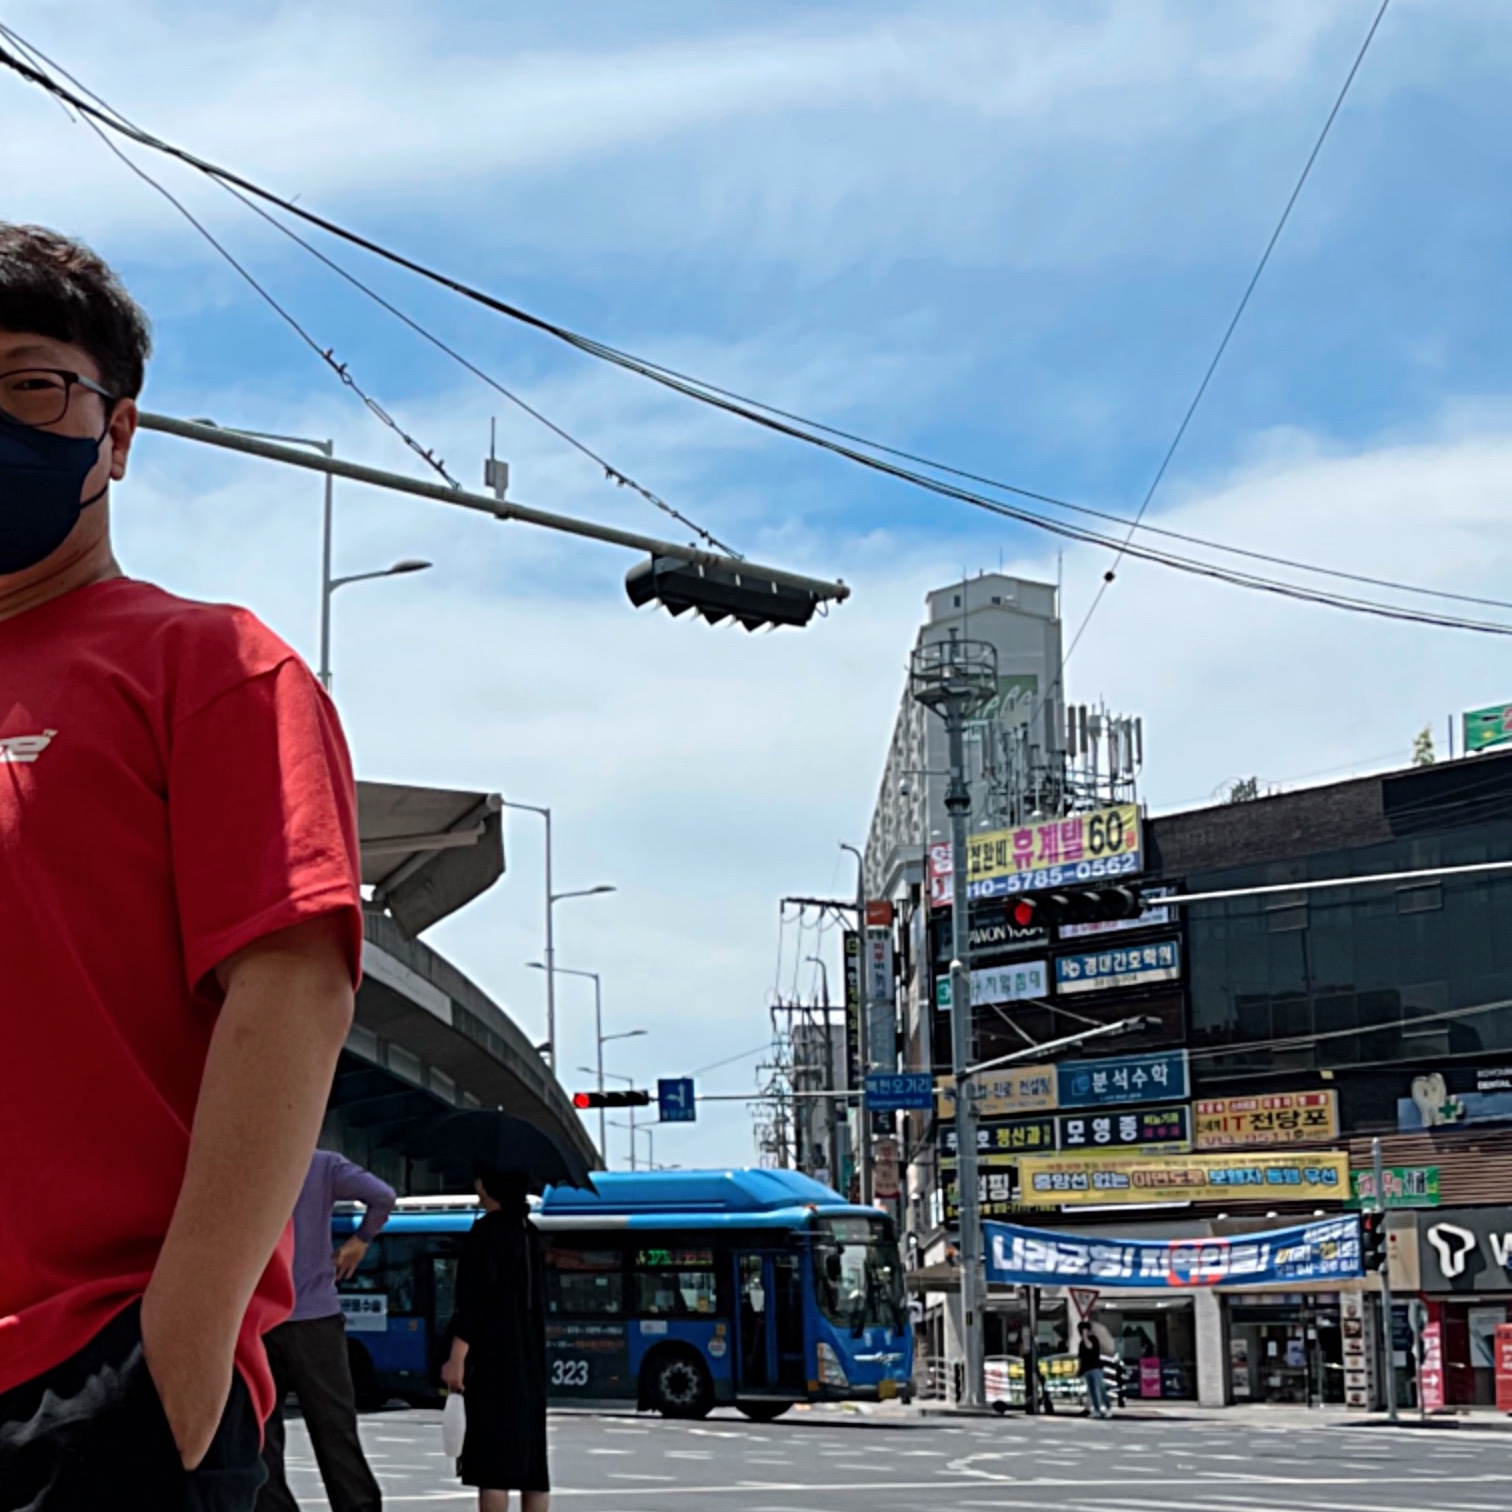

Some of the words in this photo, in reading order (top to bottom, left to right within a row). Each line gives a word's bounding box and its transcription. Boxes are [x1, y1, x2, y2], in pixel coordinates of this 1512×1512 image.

[967, 854, 1136, 898] 10-5785-0562
[1092, 1063, 1169, 1093] 분석수학
[551, 1360, 589, 1386] 323
